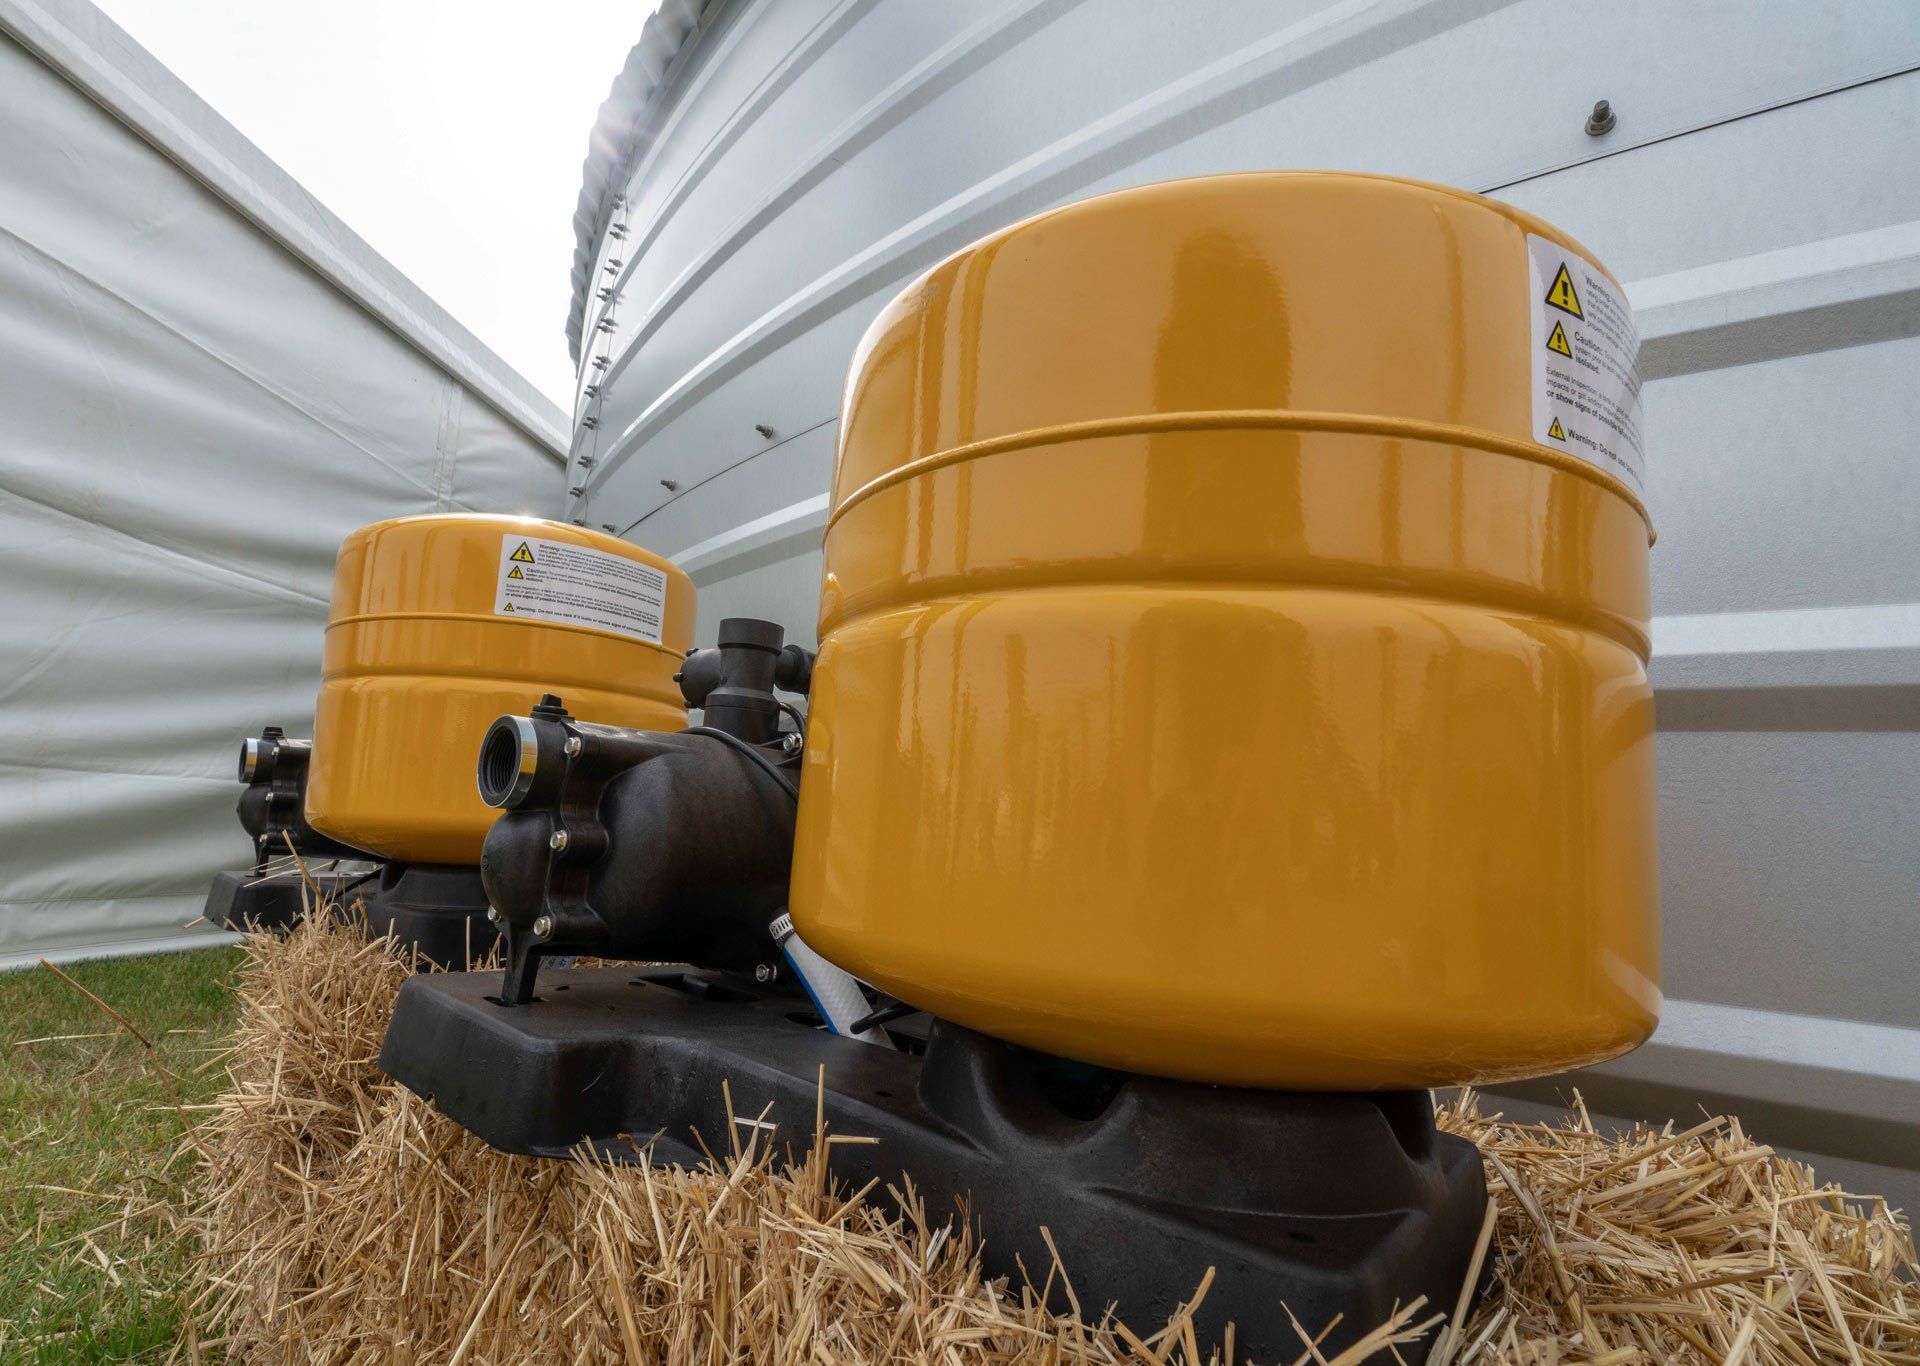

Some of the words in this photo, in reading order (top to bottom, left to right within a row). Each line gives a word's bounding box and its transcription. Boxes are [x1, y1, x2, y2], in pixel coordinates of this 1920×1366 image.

[1585, 275, 1611, 302] Warning:
[1574, 331, 1603, 355] Caution:
[1546, 366, 1571, 382] External
[1575, 354, 1600, 375] isolated.
[1546, 378, 1570, 393] impacts
[1546, 390, 1554, 398] or
[1556, 393, 1574, 406] show
[1574, 401, 1591, 414] signs
[1568, 428, 1599, 451] Warning:
[1599, 444, 1608, 455] Do
[1608, 451, 1617, 461] not
[516, 605, 536, 614] Warning:
